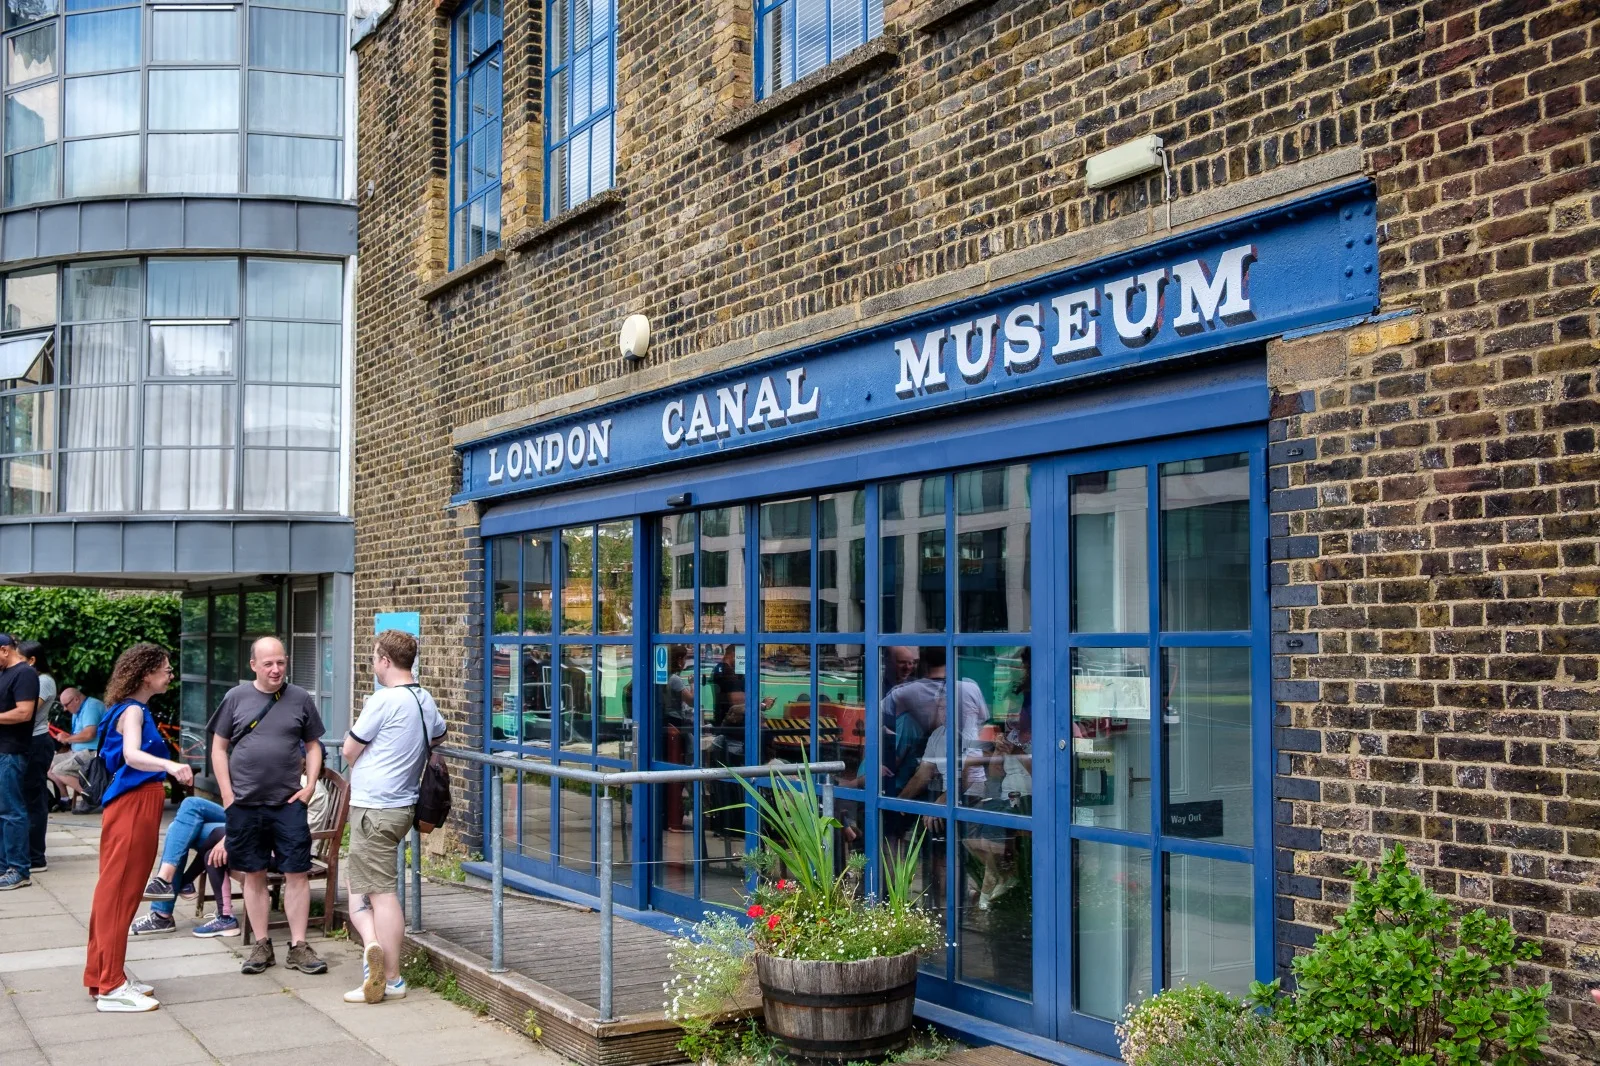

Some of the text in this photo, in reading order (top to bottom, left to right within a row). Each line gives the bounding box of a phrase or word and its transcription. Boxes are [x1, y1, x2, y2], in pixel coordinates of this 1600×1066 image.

[488, 244, 1256, 484] LONDON CANAL MUSEUM
[1171, 813, 1202, 825] Way Out
